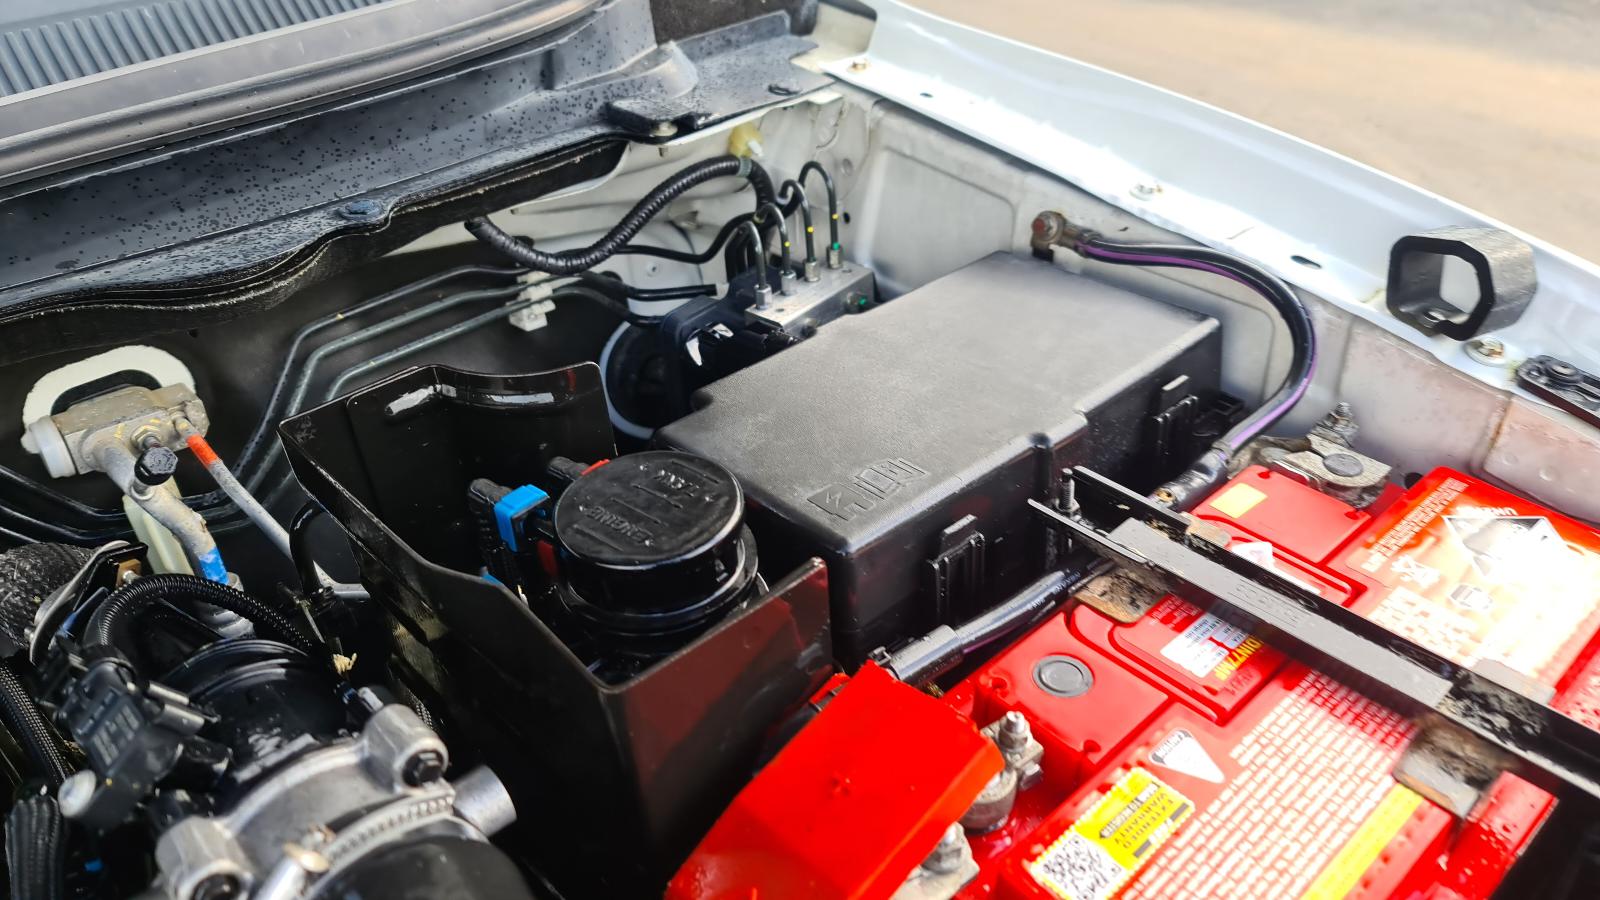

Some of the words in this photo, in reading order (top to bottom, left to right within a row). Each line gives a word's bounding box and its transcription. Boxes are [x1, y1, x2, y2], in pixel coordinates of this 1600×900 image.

[585, 505, 652, 541] ENGINE
[1112, 792, 1167, 843] WARRANTY
[1122, 799, 1173, 848] EXTENDED
